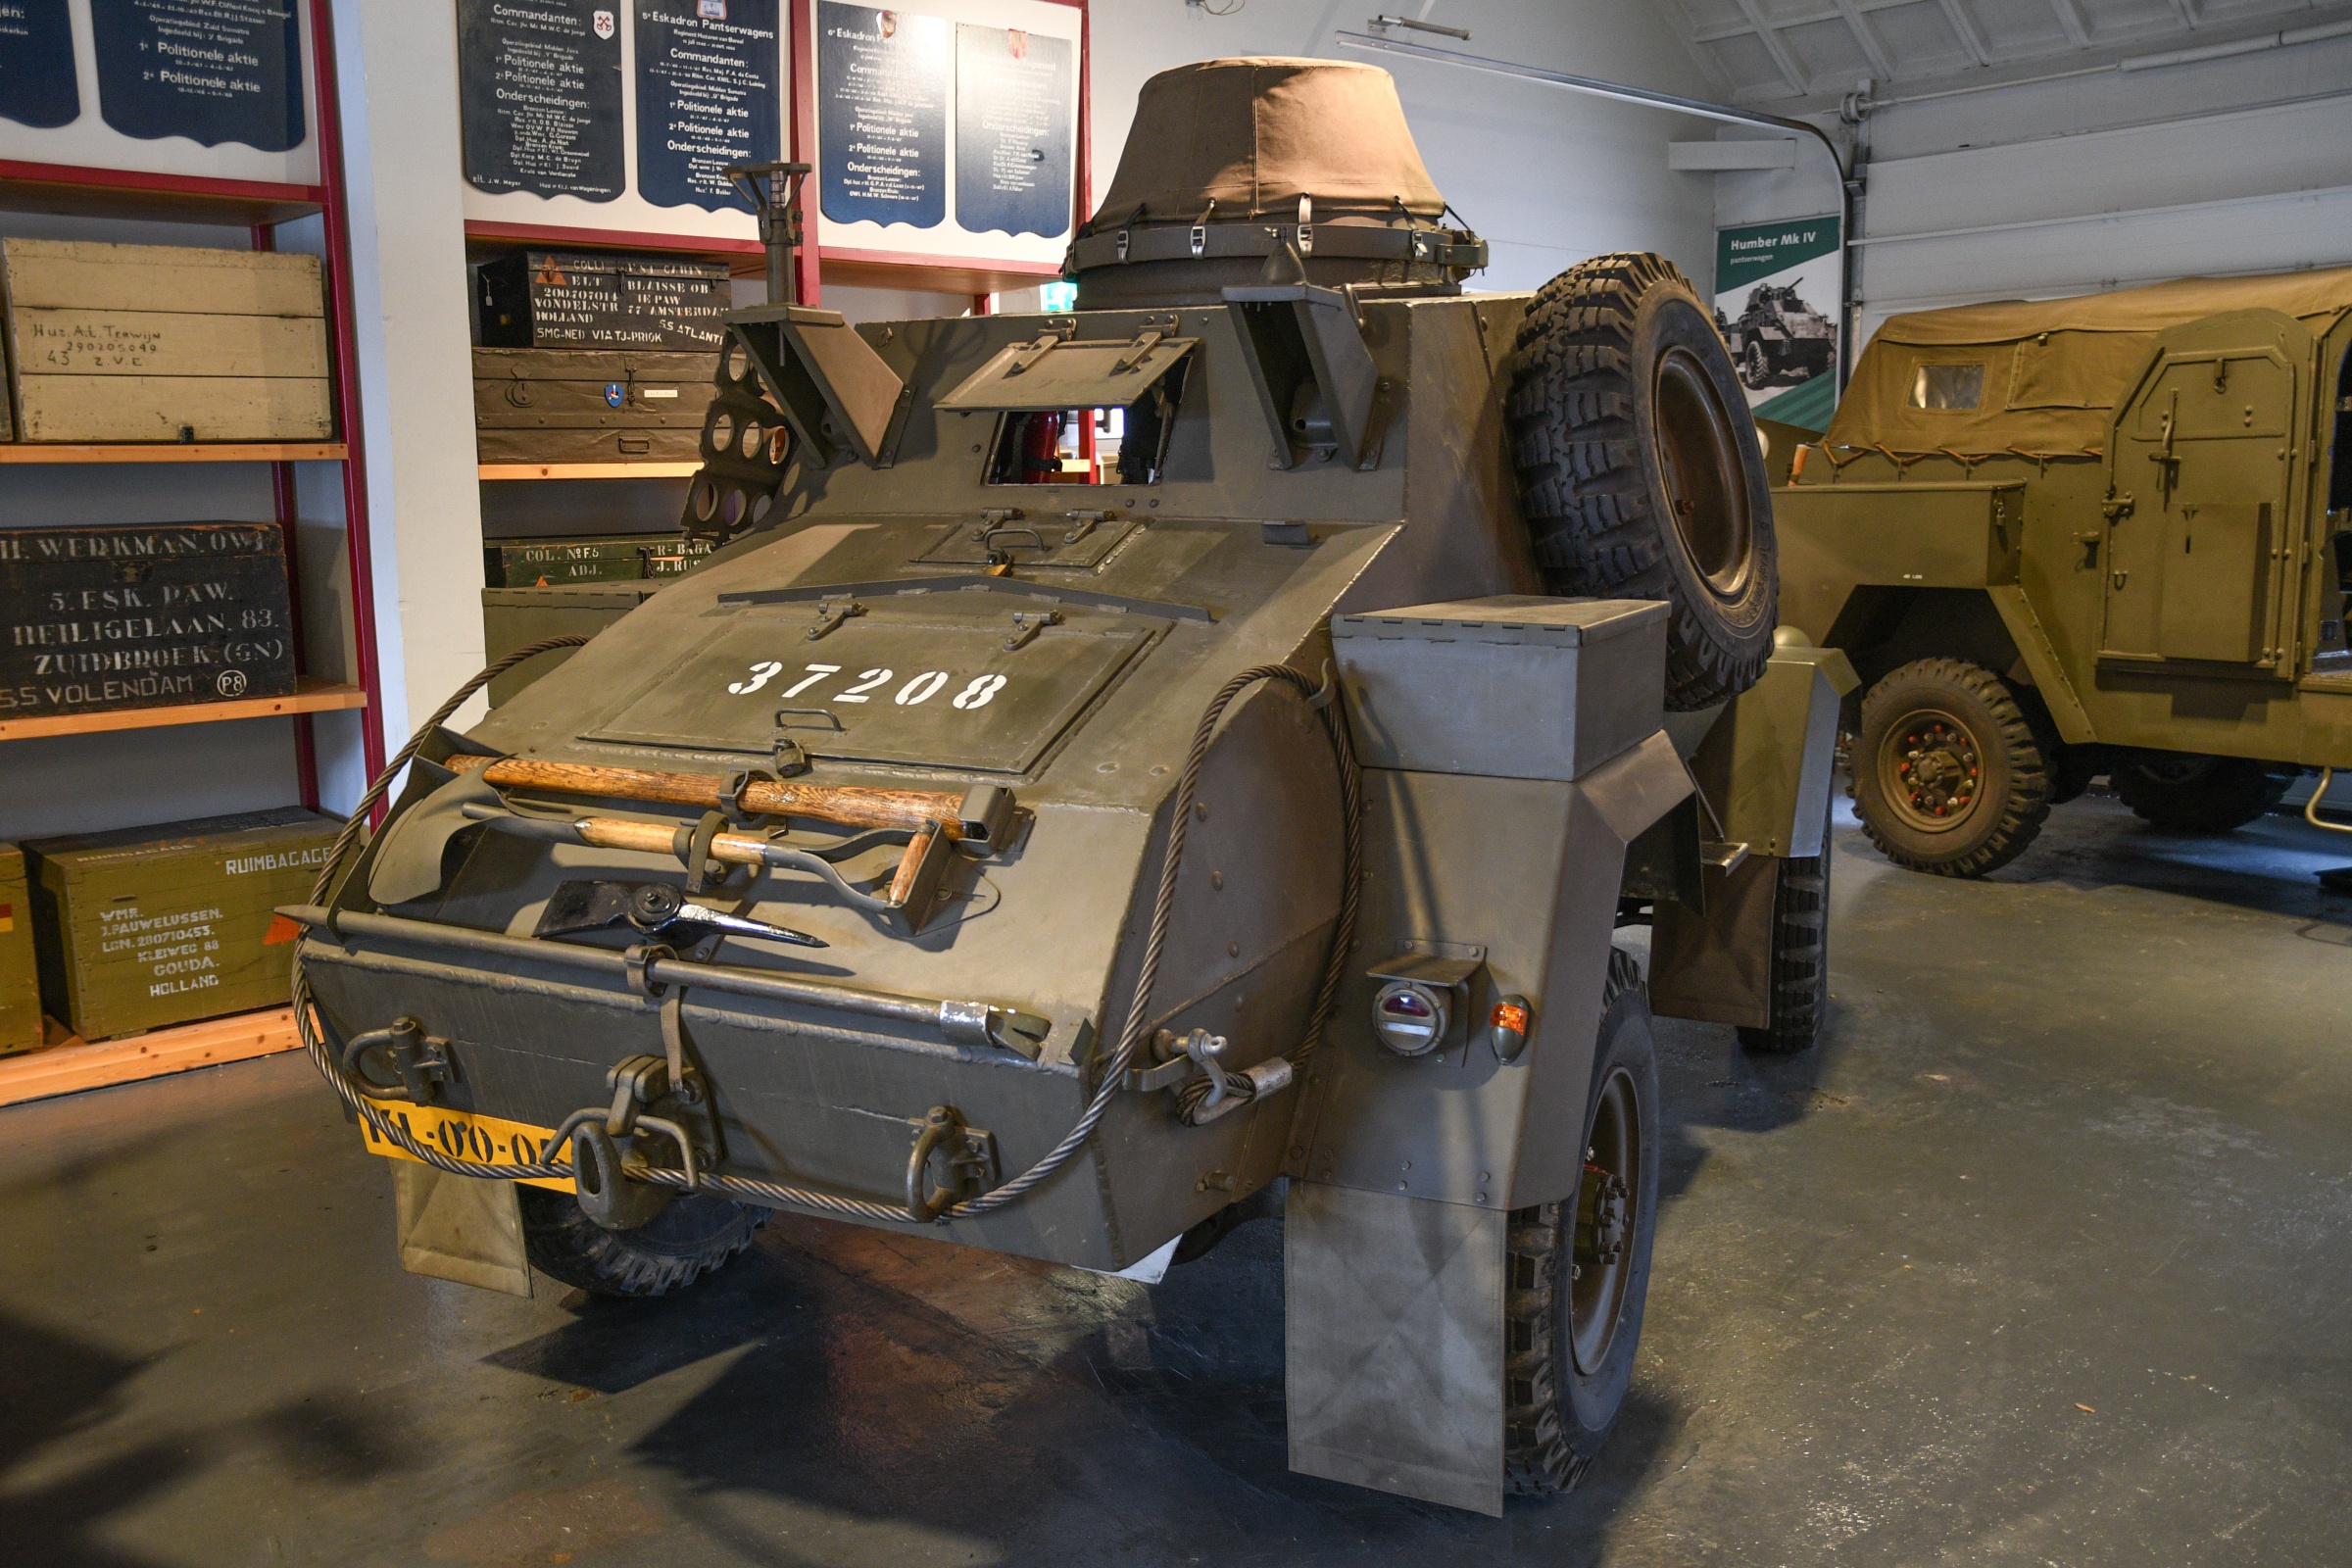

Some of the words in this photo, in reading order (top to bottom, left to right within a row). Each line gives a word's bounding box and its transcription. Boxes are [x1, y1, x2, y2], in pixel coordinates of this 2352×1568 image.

[652, 11, 698, 28] Eskadron
[702, 19, 774, 39] Pantserwagens
[836, 27, 875, 42] Eskadron
[157, 41, 224, 62] Politionele
[227, 52, 259, 67] aktie
[504, 54, 555, 71] Politionele
[559, 63, 584, 74] aktie
[160, 70, 226, 89] Politionele
[229, 80, 261, 93] aktie
[505, 71, 556, 86] Politionele
[560, 77, 585, 89] aktie
[496, 88, 590, 110] Onderscheidingen:
[677, 100, 723, 115] Politionele
[726, 106, 749, 118] aktie
[677, 121, 723, 136] Politionele
[727, 127, 750, 138] aktie
[857, 122, 897, 135] Politionele
[899, 128, 919, 138] aktie
[667, 139, 752, 160] Onderscheidingen:
[857, 143, 897, 156] Politionele
[899, 148, 919, 158] aktie
[847, 161, 921, 178] Onderscheidingen:
[1730, 236, 1778, 251] Humber
[1780, 232, 1800, 246] Mk
[1803, 230, 1817, 243] IV
[573, 260, 605, 271] COLLI
[1730, 254, 1774, 266] pantserwagen
[571, 275, 603, 287] ELT
[627, 280, 686, 293] BLAISSE
[690, 282, 710, 294] OB
[533, 297, 618, 314] VONDELSTR
[627, 305, 642, 316] 77
[655, 294, 681, 306] PAW
[535, 311, 594, 323] HOLLAND
[591, 329, 612, 341] VIA
[614, 329, 662, 343] TJ-PRIOK
[46, 674, 195, 706] VOLENDAM
[221, 674, 243, 693] P8
[727, 661, 1007, 710] 37208
[99, 907, 143, 922] WMR.
[137, 943, 197, 963] KLEIWEG
[203, 939, 220, 952] 88
[148, 974, 220, 998] HOLLAND
